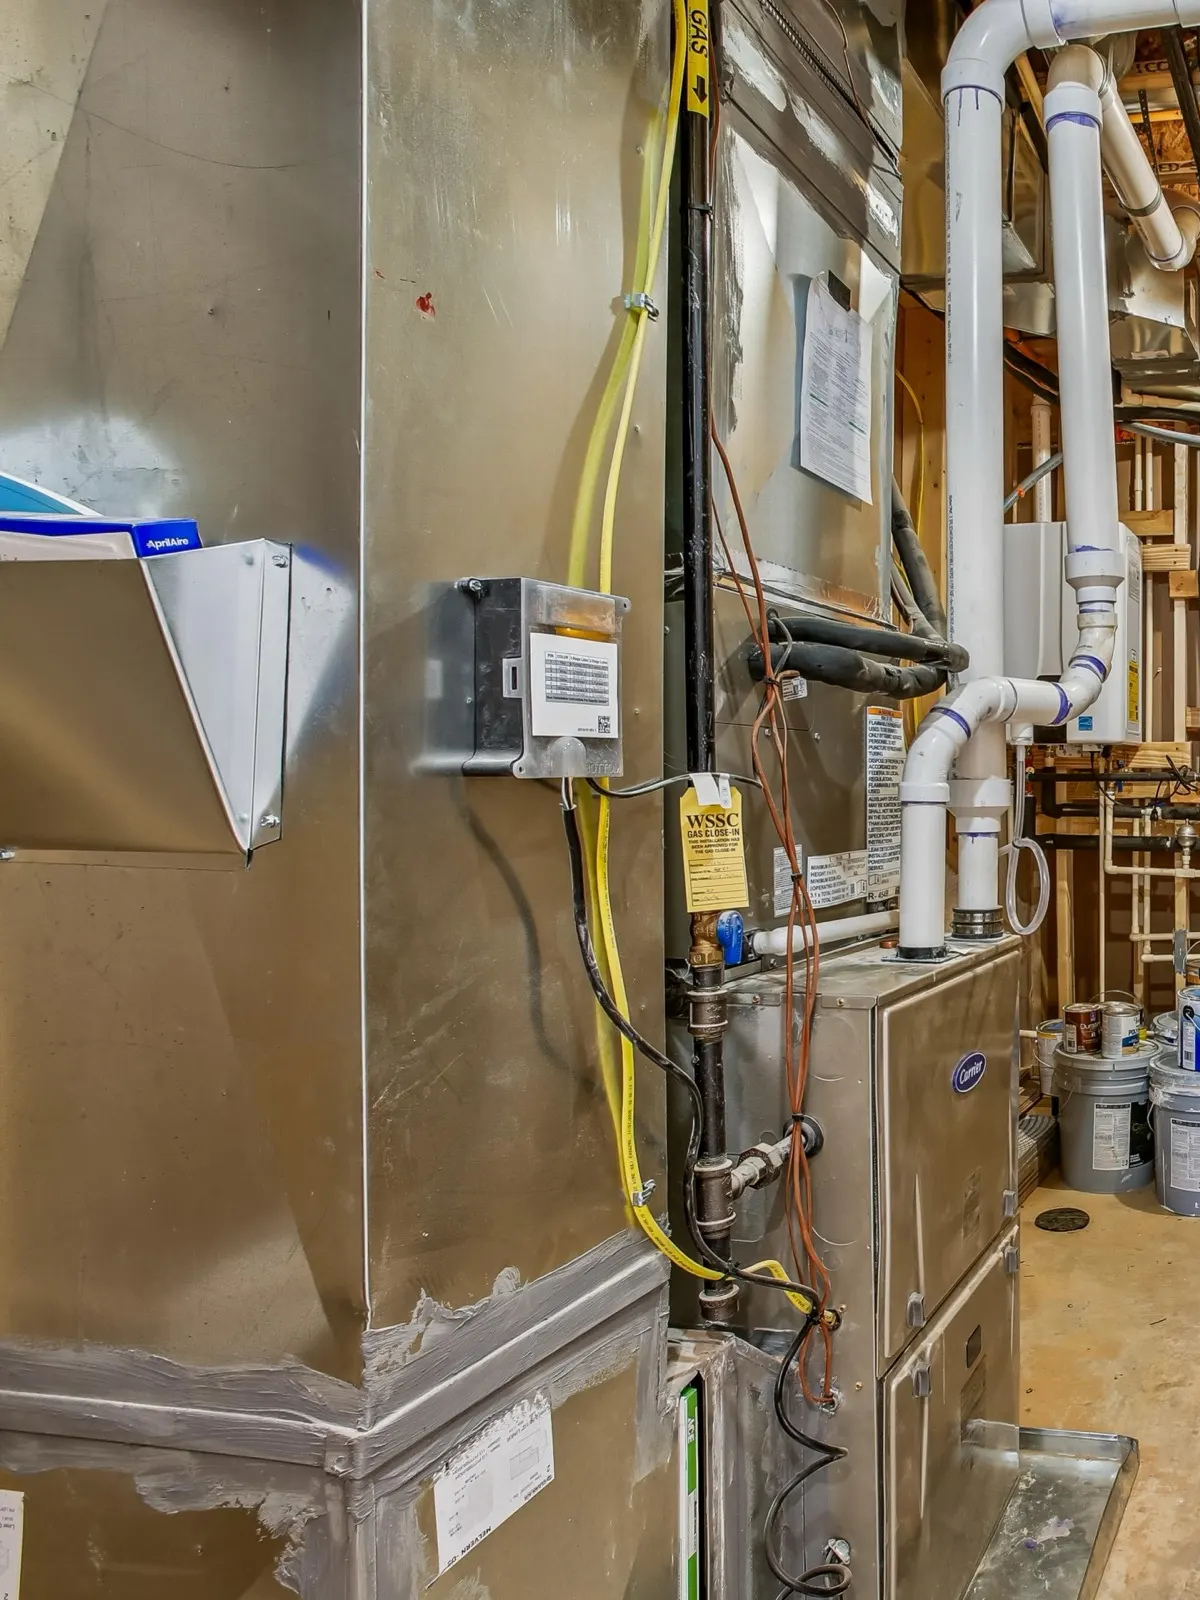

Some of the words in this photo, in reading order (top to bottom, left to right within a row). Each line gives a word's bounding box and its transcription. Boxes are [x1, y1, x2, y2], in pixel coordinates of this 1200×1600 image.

[691, 9, 708, 58] GAS
[146, 538, 189, 550] AprilAire
[687, 813, 739, 829] WSSC
[687, 830, 703, 838] GAS
[705, 828, 740, 838] CLOSE-IN
[959, 1060, 983, 1085] Carrier
[687, 1418, 695, 1444] ACE
[461, 1526, 492, 1555] MELVERN
